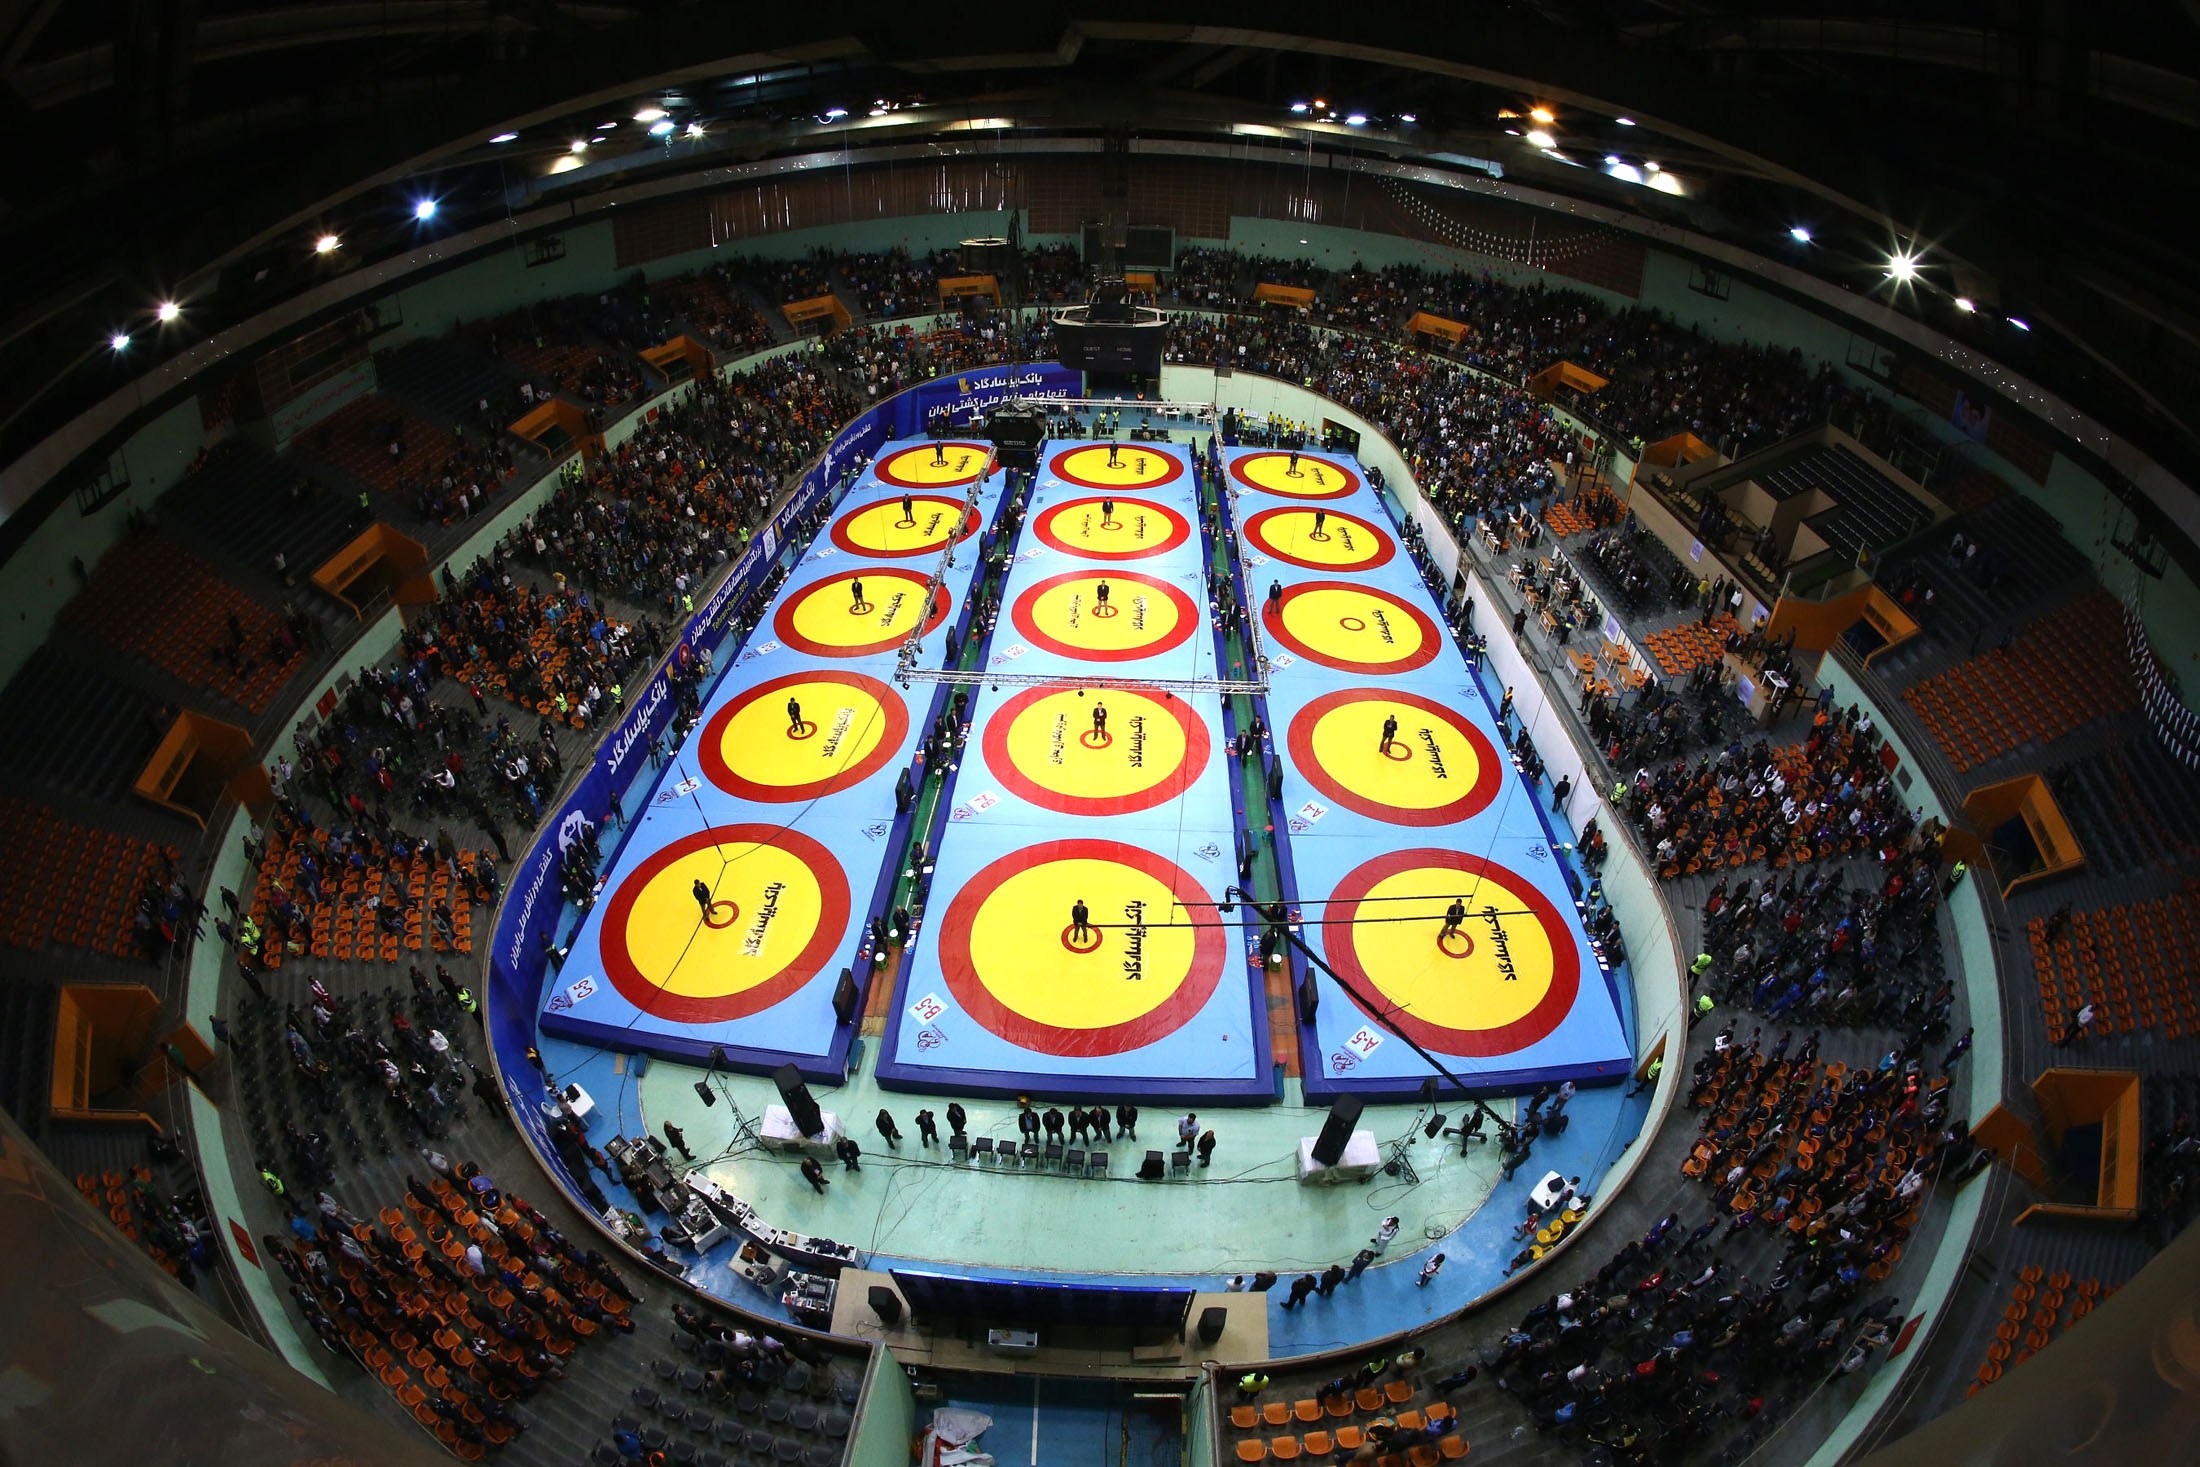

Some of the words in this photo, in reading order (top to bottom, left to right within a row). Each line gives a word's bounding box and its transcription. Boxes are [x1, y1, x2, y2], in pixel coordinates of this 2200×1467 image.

[980, 395, 999, 408] ملی
[1046, 389, 1067, 399] تنها
[802, 481, 815, 501] بانک
[782, 494, 805, 528] پاسارگاد
[645, 680, 667, 715] بانک
[607, 709, 650, 775] پاسارگاد
[1306, 803, 1326, 819] A-4
[536, 847, 553, 887] کشتی
[524, 881, 542, 919] ورزش
[517, 913, 529, 943] ملی
[510, 933, 523, 970] ایران
